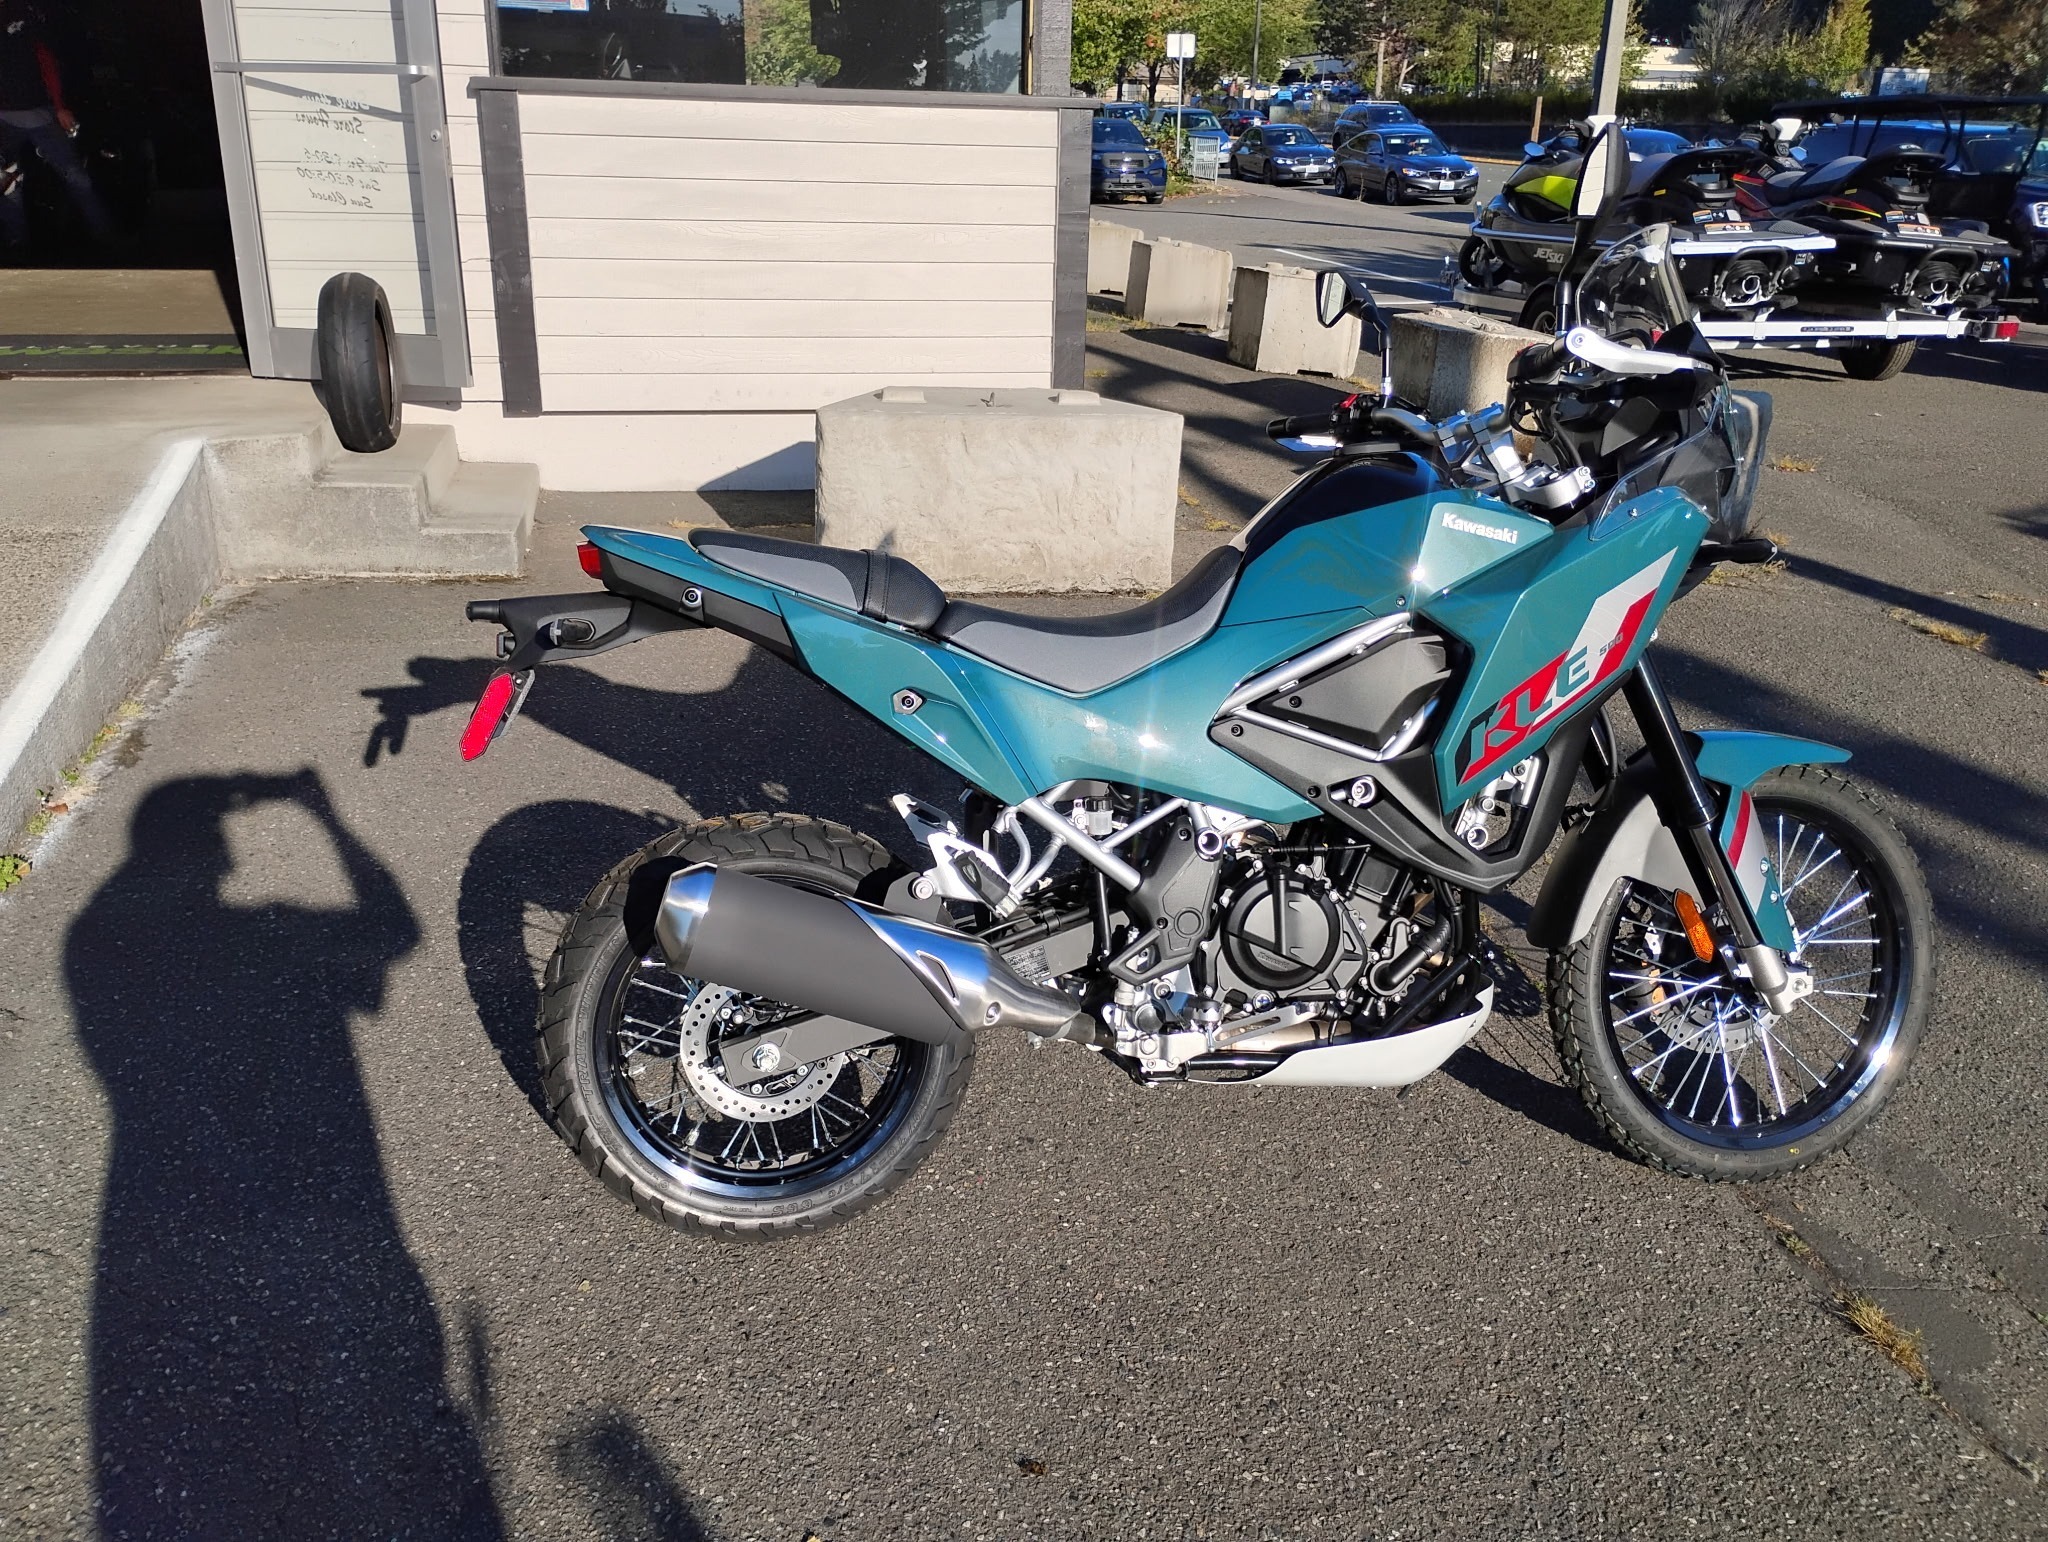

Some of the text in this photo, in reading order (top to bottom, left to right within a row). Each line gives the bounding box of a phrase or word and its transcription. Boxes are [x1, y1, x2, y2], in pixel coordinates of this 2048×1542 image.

[1533, 247, 1565, 264] JET SKI
[1442, 512, 1518, 545] Kawasaki
[1599, 633, 1624, 657] 500
[1470, 645, 1590, 761] KLE
[574, 1029, 595, 1099] TRAIL
[770, 1198, 814, 1215] 66S
